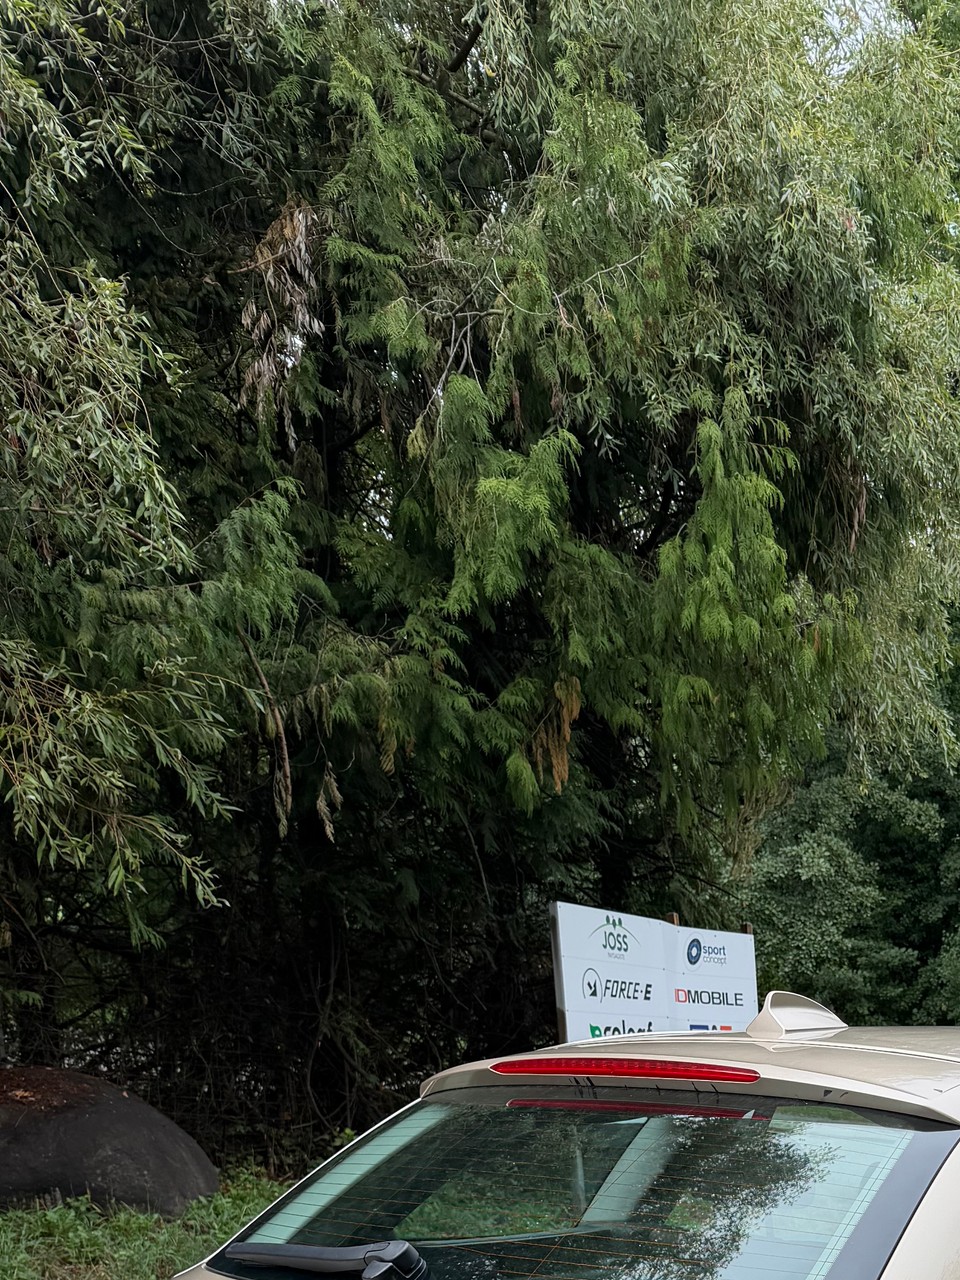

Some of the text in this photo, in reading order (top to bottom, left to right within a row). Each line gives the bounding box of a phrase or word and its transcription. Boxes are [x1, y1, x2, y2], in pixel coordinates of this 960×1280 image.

[602, 930, 629, 952] JOSS
[702, 945, 727, 957] sport
[674, 988, 744, 1007] IDMOBILE
